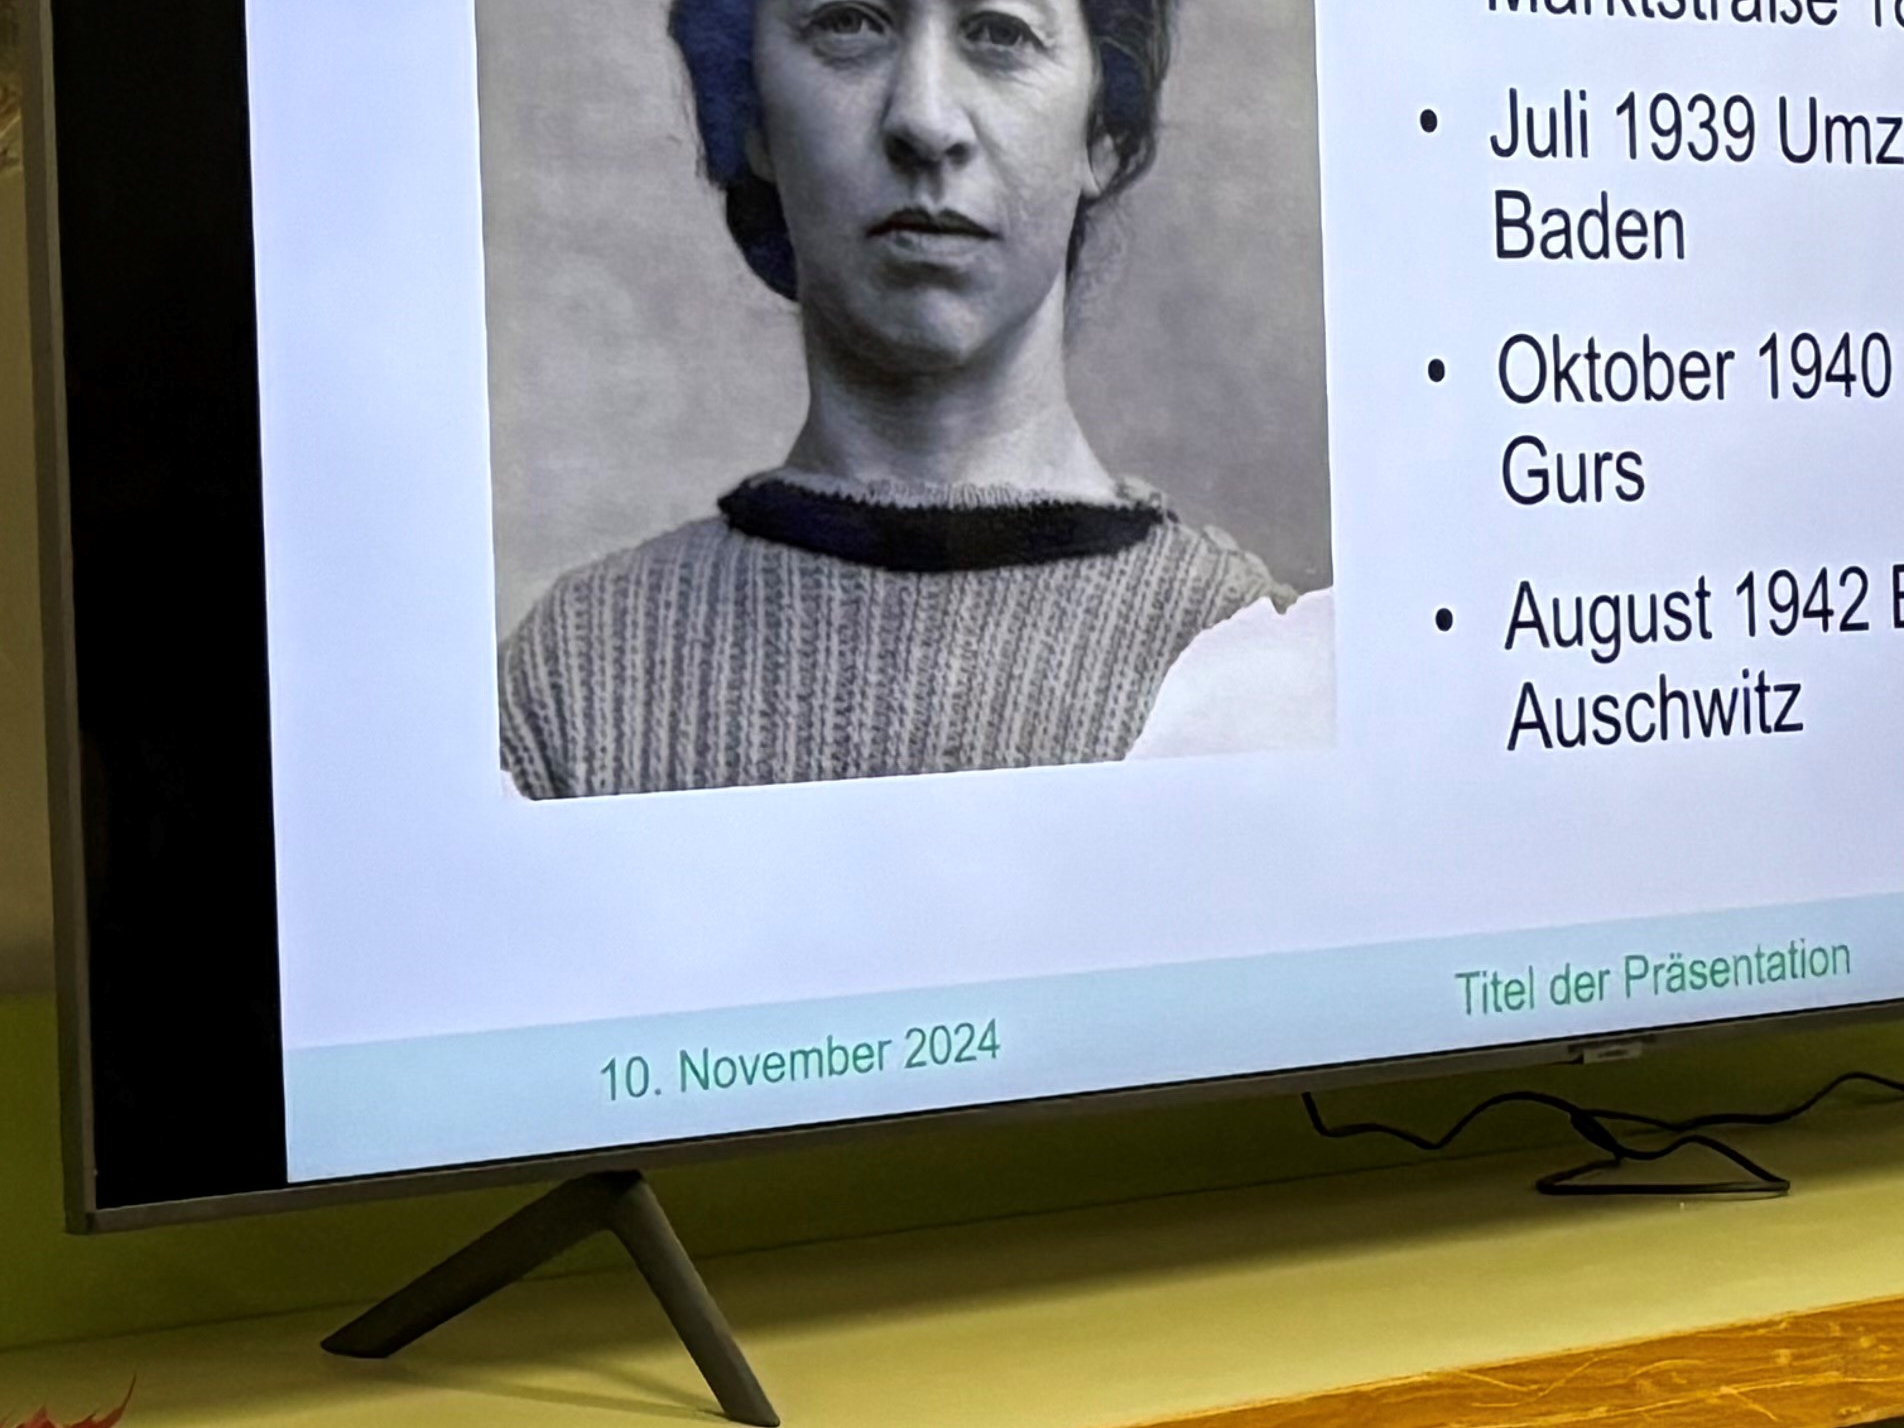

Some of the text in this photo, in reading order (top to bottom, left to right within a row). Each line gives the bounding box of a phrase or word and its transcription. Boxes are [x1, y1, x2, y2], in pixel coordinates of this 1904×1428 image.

[1490, 88, 1588, 158] Juli
[1616, 92, 1755, 162] 1939
[1495, 190, 1684, 260] Baden
[1499, 334, 1735, 404] Oktober
[1759, 332, 1891, 399] 1940
[1503, 435, 1644, 505] Gurs
[1505, 575, 1712, 664] August
[1736, 566, 1869, 637] 1942
[1507, 669, 1803, 751] Auschwitz
[1455, 938, 1850, 1015] Titel der Präsentation
[601, 1019, 1000, 1101] 10. November 2024
